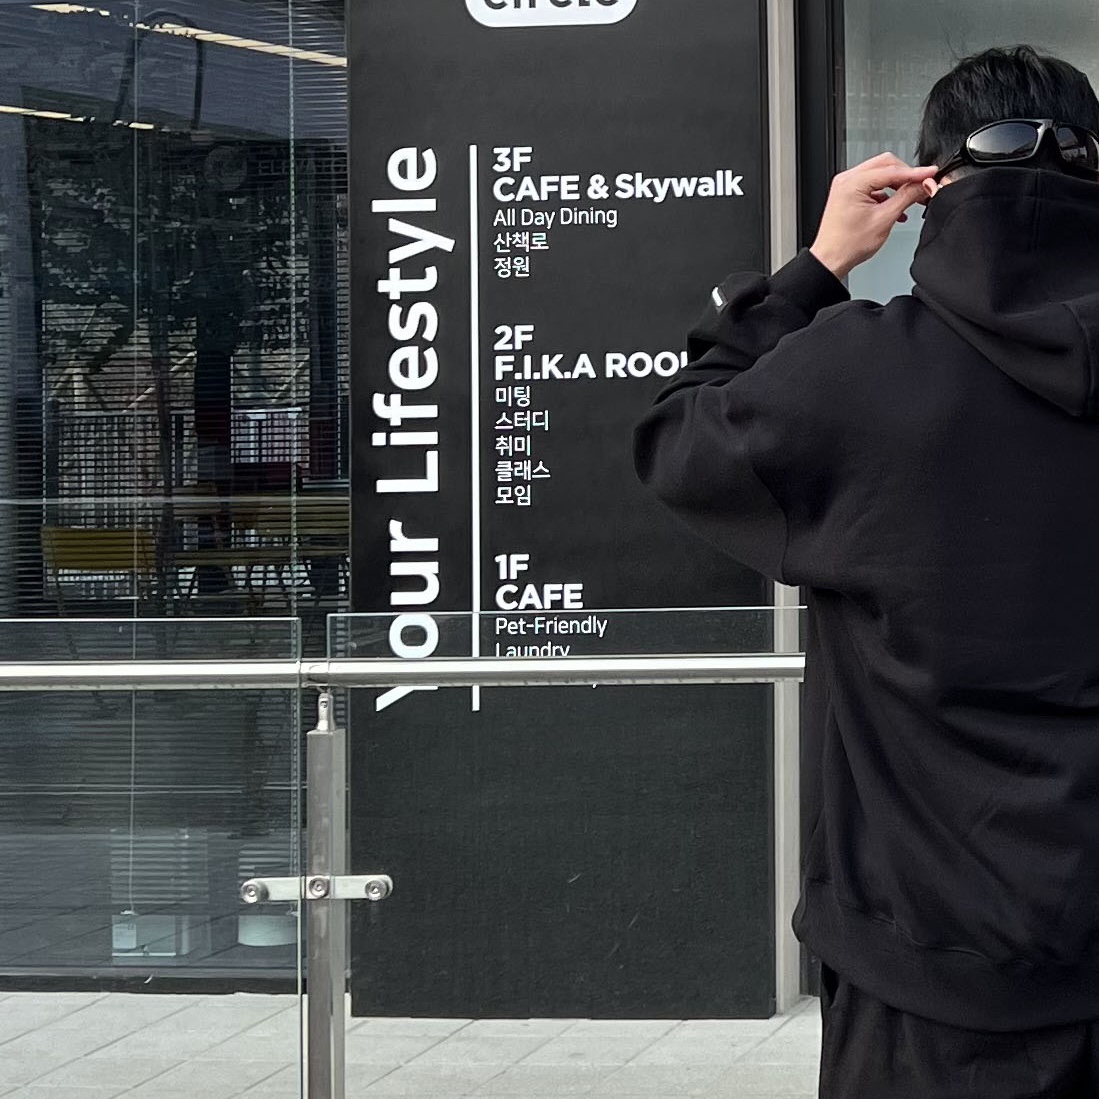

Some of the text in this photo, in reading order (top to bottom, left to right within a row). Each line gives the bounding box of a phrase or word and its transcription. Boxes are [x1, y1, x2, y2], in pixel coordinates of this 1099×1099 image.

[493, 147, 532, 172] 3F
[493, 170, 743, 202] CAFE & Skywalk
[494, 207, 617, 229] All Day Dining
[494, 232, 549, 252] 산책로
[494, 256, 529, 278] 정원
[372, 147, 455, 492] Lifestyle
[494, 325, 534, 350] 2F
[496, 351, 687, 380] F.I.K.A ROO
[496, 386, 530, 407] 미팅
[495, 410, 548, 431] 스터디
[496, 435, 530, 456] 취미
[495, 460, 550, 481] 클래스
[495, 485, 530, 505] 모임
[495, 554, 529, 579] 1F
[496, 584, 583, 609] CAFE
[496, 616, 607, 637] Pet-Friendly
